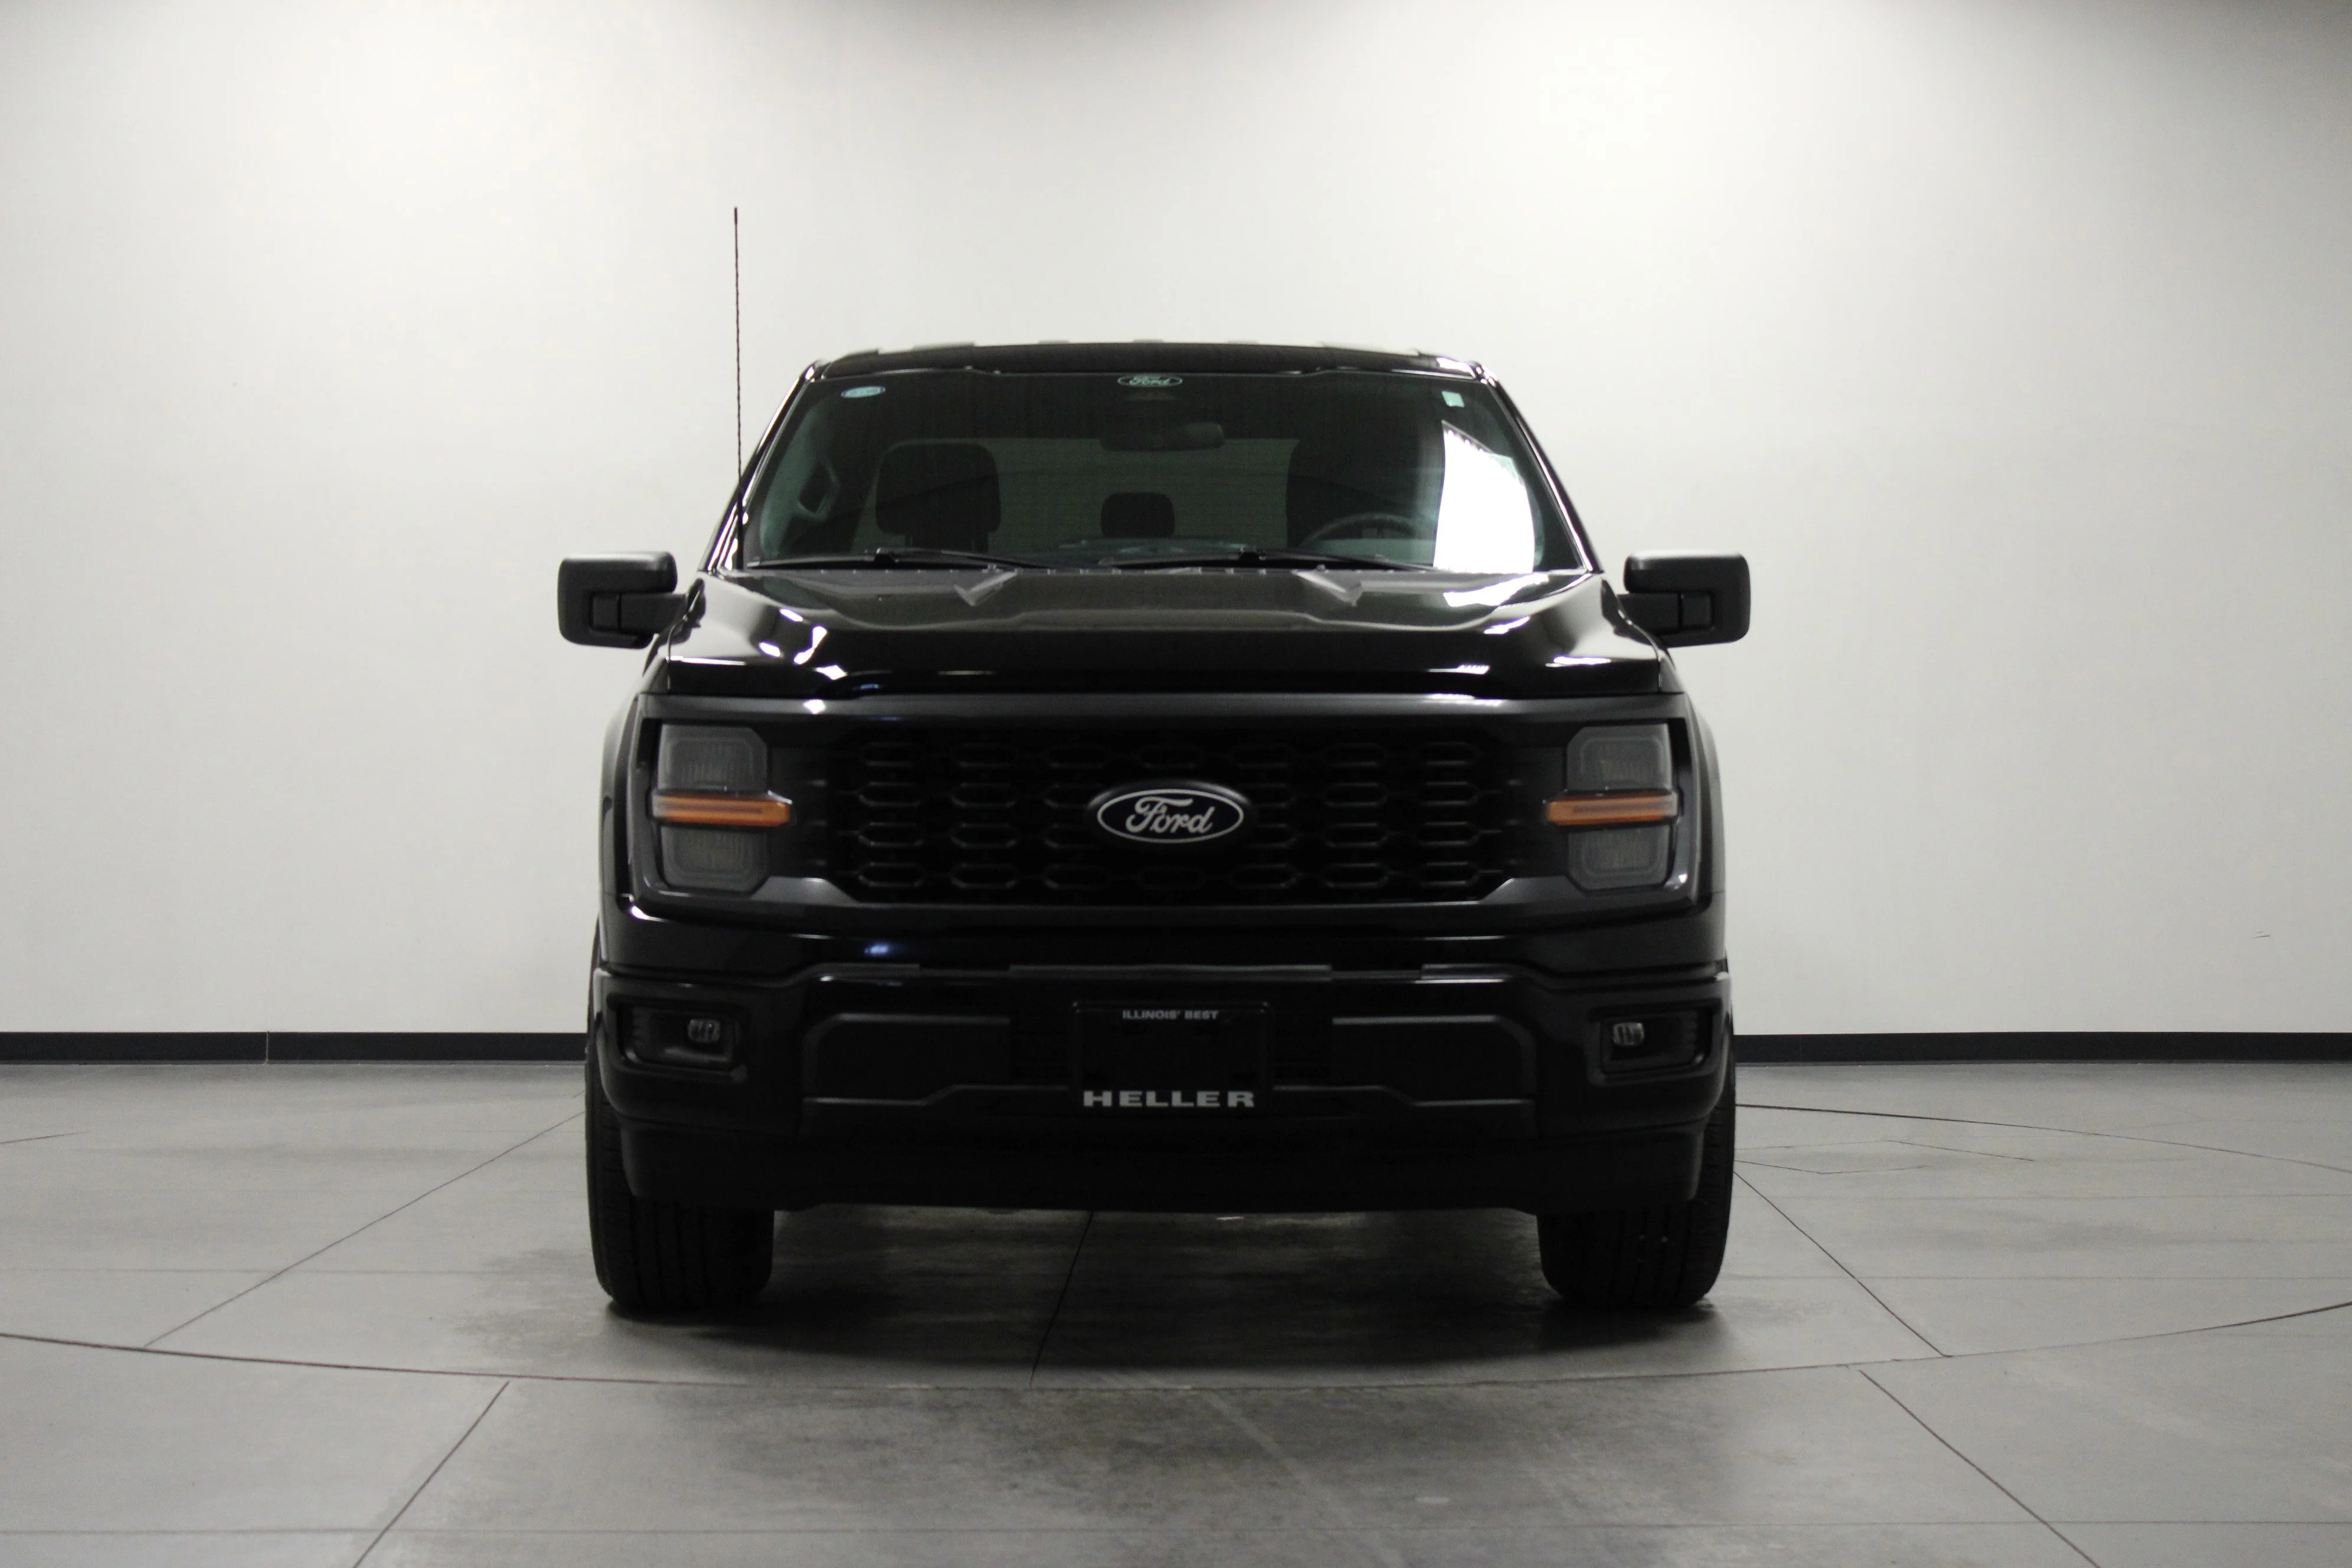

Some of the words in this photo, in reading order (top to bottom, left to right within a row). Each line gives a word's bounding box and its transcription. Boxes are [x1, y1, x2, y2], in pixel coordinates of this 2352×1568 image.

[1129, 375, 1171, 386] Ford
[1125, 796, 1215, 834] Ford
[1184, 1010, 1220, 1020] BEST
[1083, 1090, 1255, 1108] HELLER
